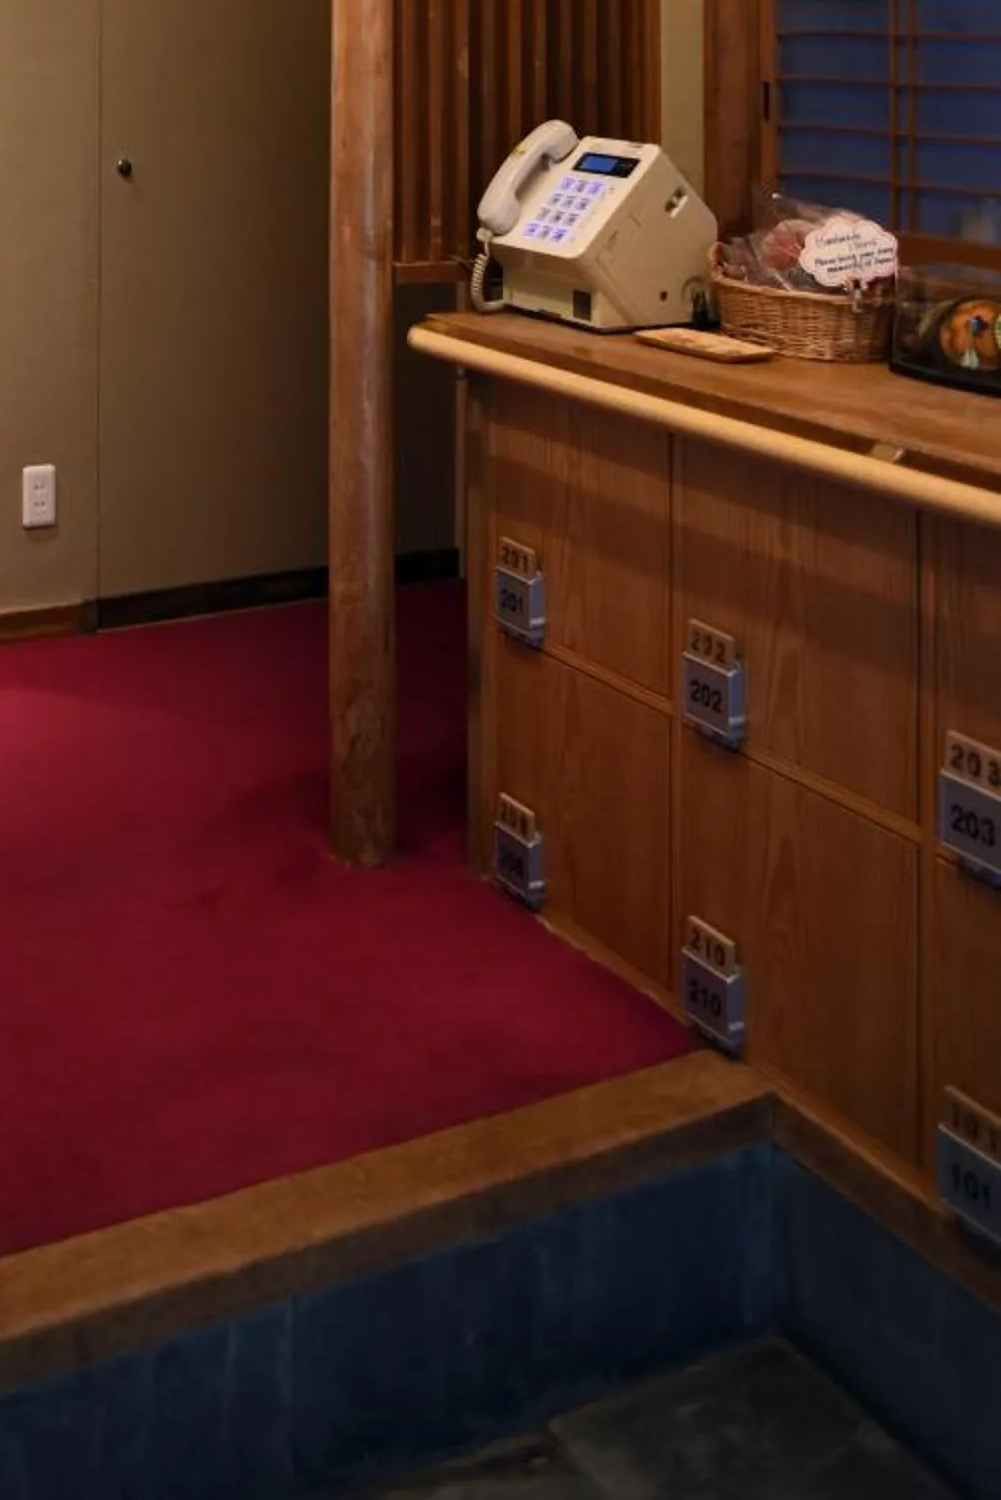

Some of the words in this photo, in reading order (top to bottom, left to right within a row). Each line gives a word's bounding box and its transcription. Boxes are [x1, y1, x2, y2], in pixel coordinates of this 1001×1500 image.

[501, 545, 529, 573] 201
[500, 588, 525, 616] 201
[691, 630, 726, 664] 202
[690, 679, 724, 714] 202
[950, 743, 1001, 788] 203
[950, 803, 996, 848] 203
[690, 927, 727, 967] 210
[689, 978, 723, 1018] 210
[950, 1162, 992, 1212] 101
